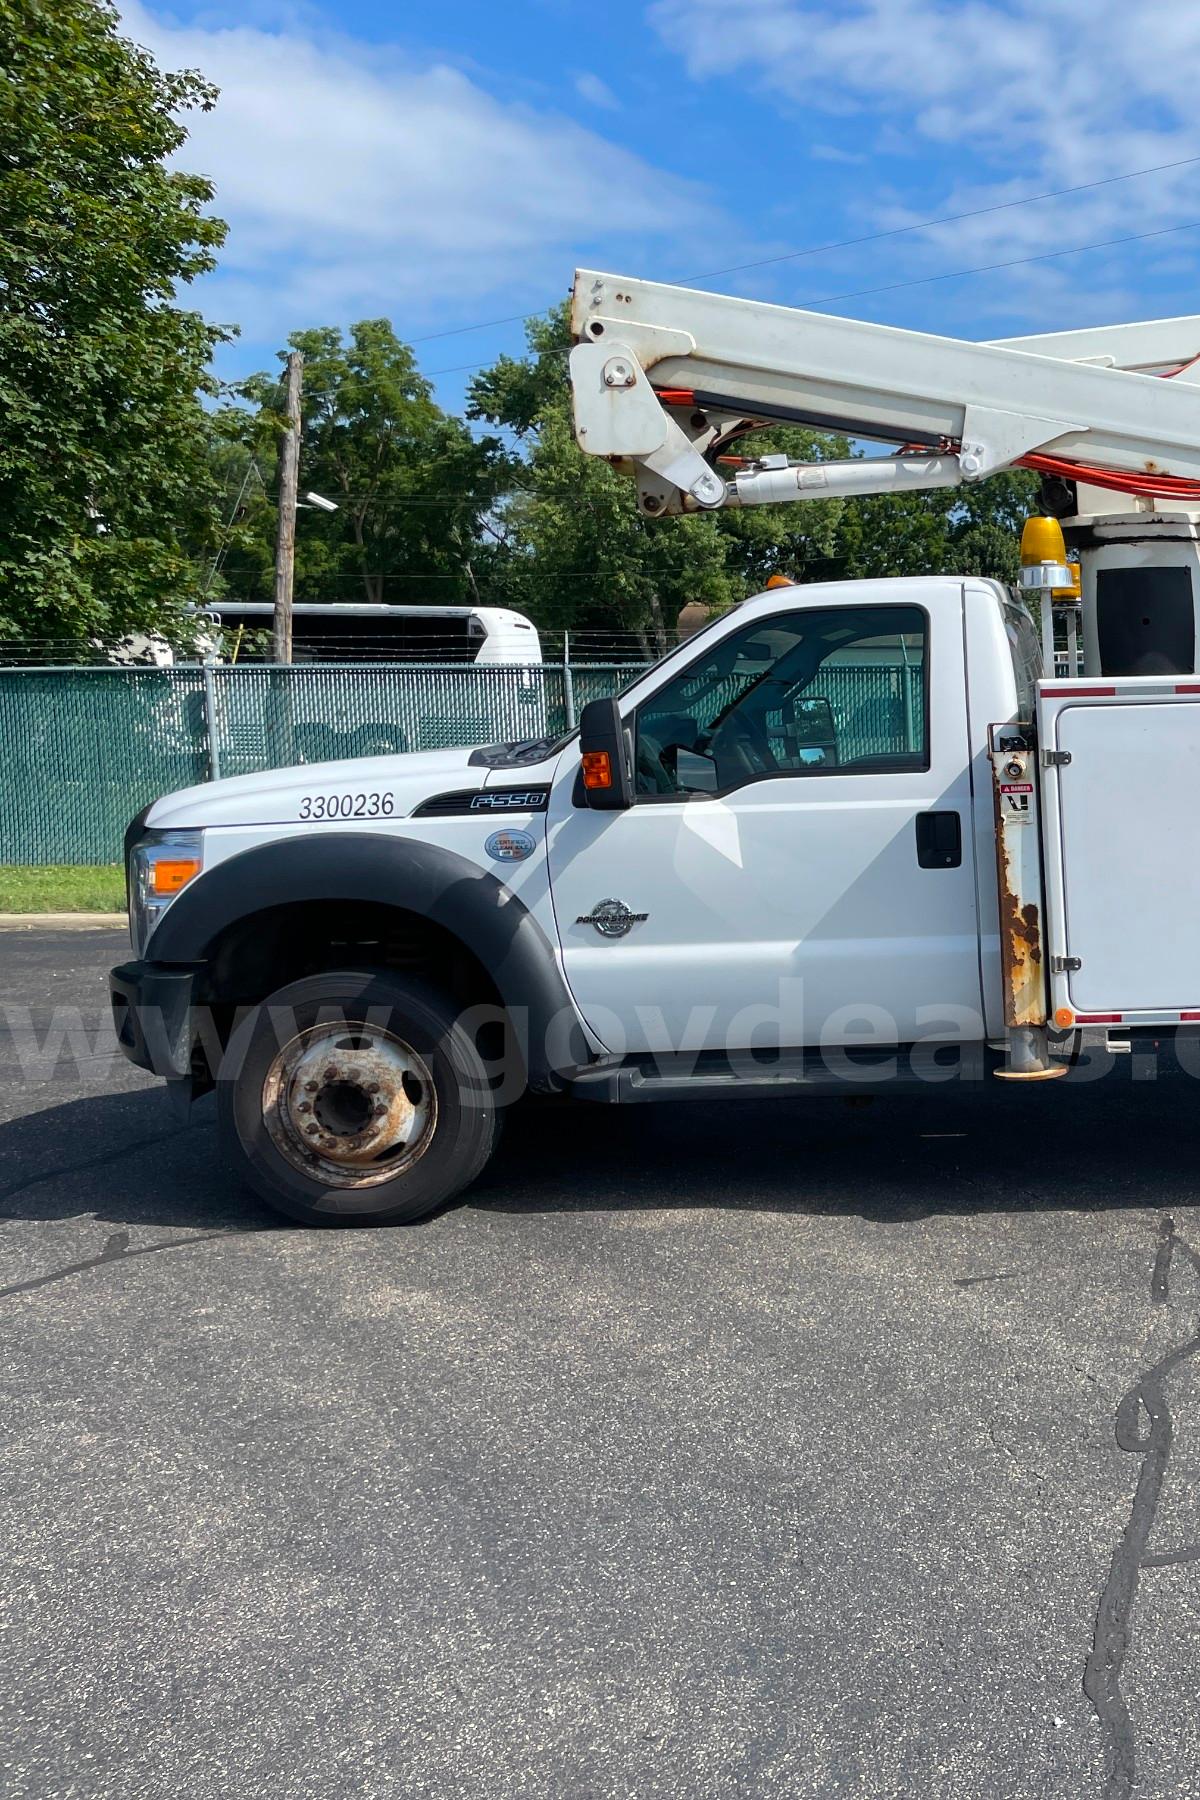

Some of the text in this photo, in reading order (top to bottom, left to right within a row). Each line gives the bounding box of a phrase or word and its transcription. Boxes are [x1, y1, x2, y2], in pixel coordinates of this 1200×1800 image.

[299, 792, 394, 819] 3300236
[575, 913, 649, 924] POWER STROKE
